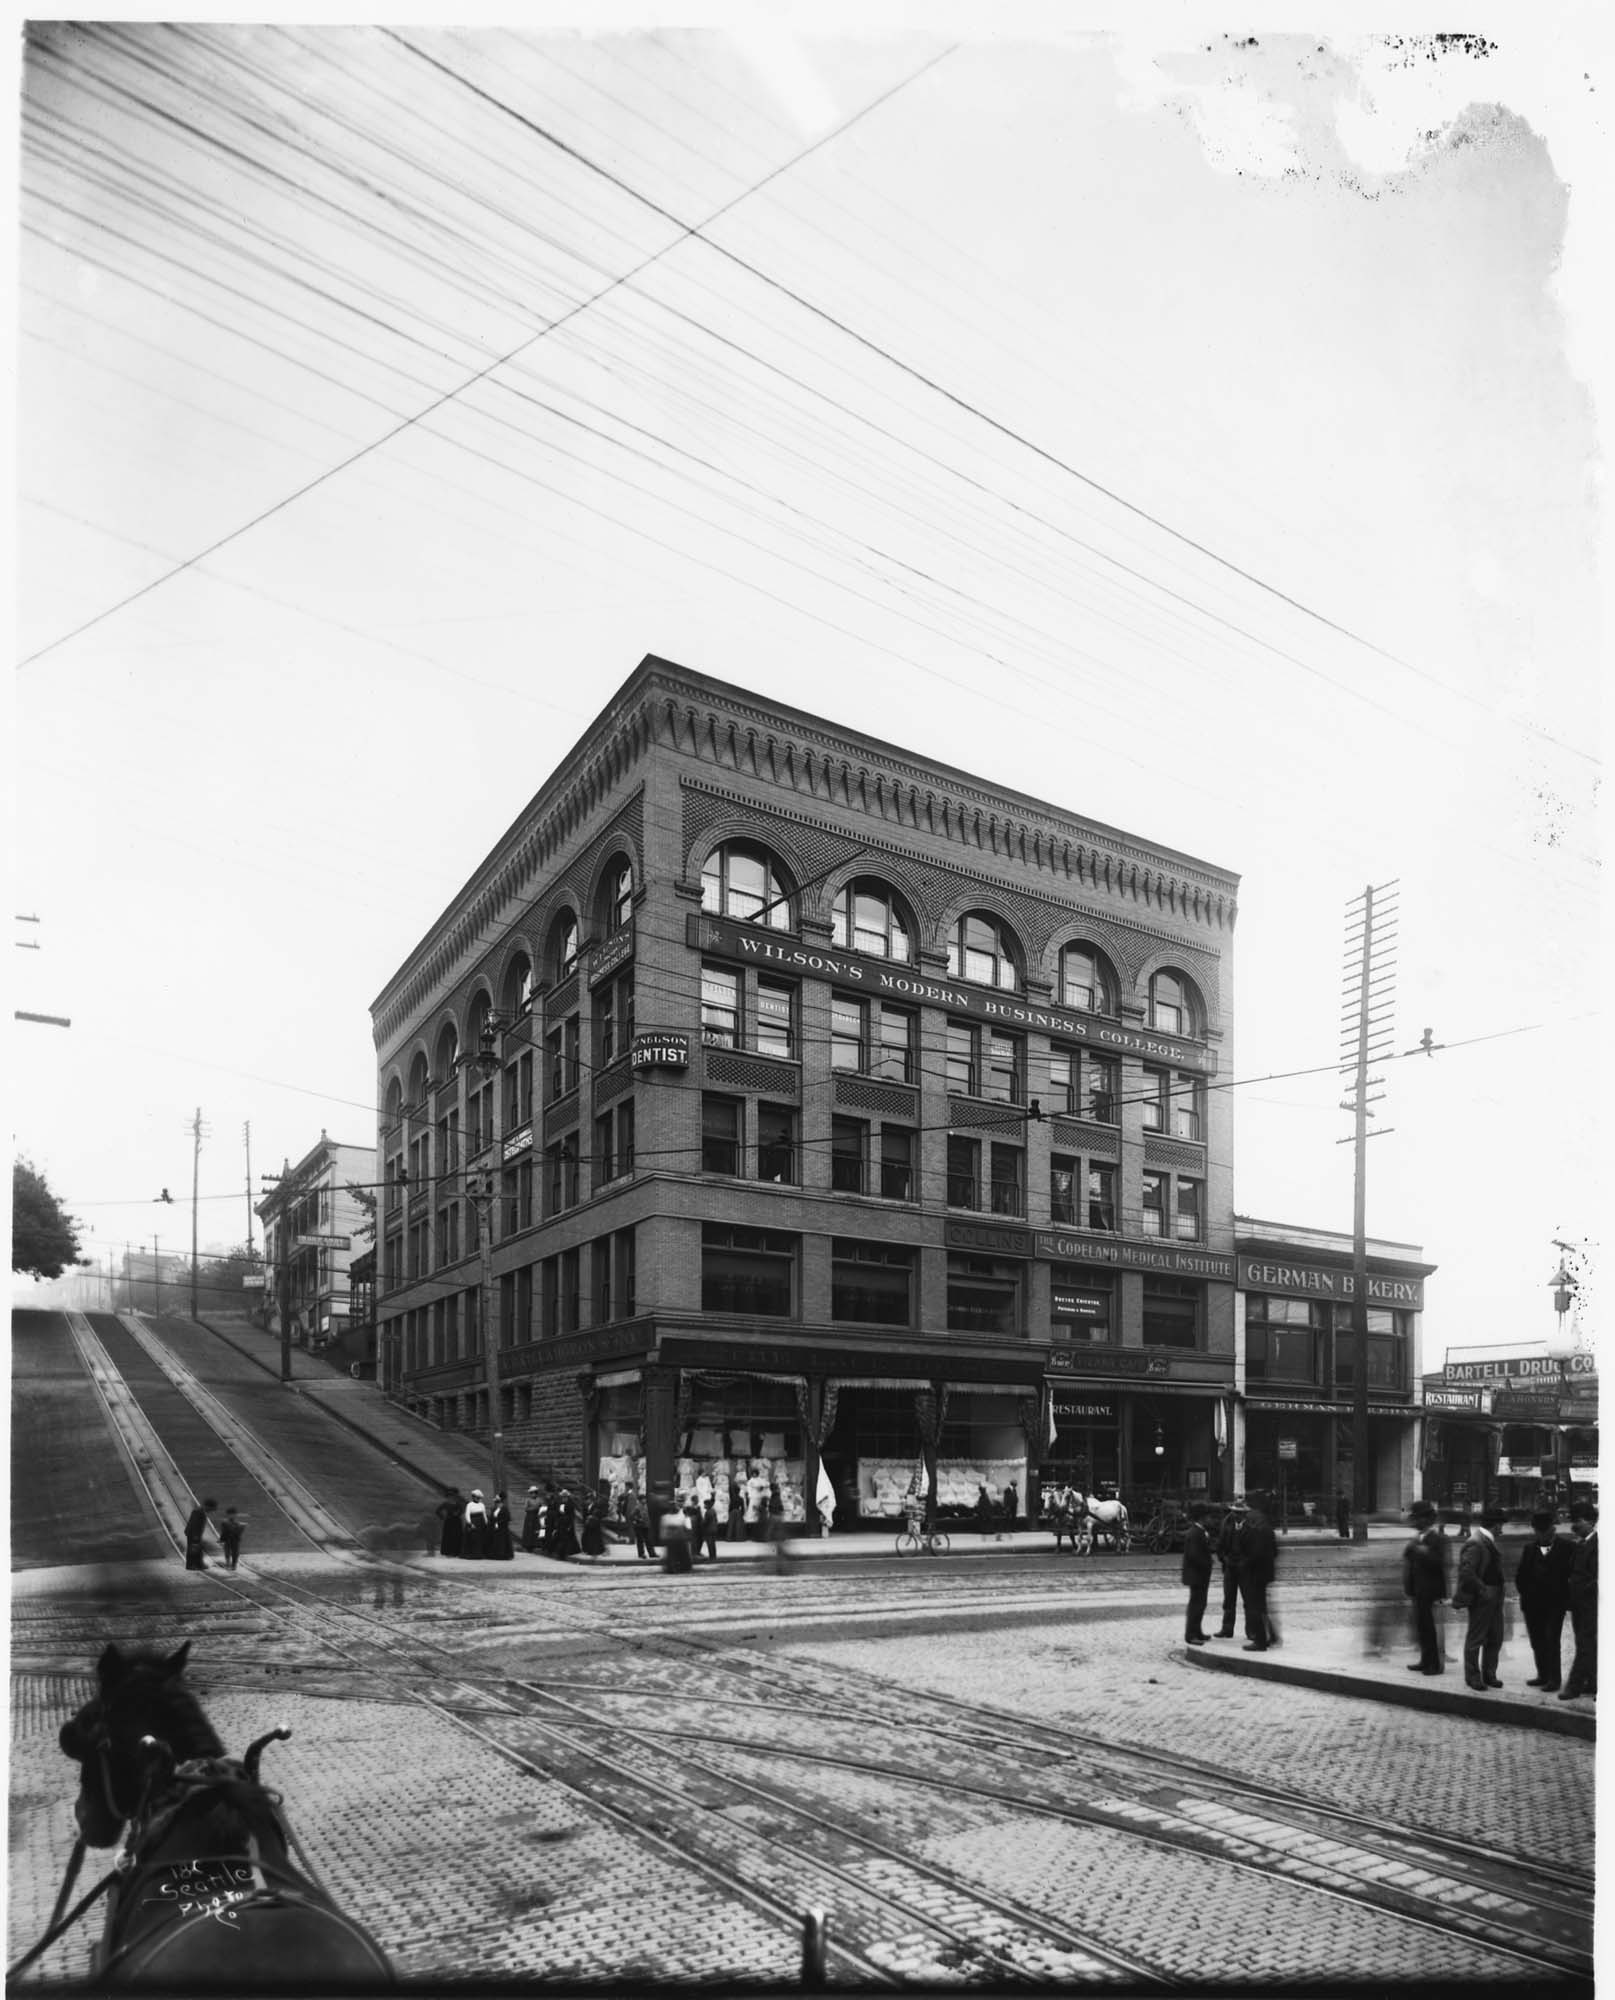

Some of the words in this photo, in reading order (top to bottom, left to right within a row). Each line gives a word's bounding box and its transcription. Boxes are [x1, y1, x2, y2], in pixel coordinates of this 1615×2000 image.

[739, 937, 864, 980] WILSON'S
[880, 974, 969, 1007] MODERN
[985, 1002, 1088, 1036] BUSINESS
[631, 1048, 688, 1067] DENTIST.
[1039, 1235, 1055, 1247] THE
[1057, 1238, 1118, 1262] COPELAND
[1122, 1248, 1172, 1267] MEDICAL
[1175, 1254, 1231, 1275] INSTITUTE
[1248, 1264, 1334, 1291] GERMAN
[1343, 1276, 1418, 1303] BKERY.
[1446, 1364, 1514, 1381] BARTELL
[1425, 1392, 1480, 1408] RESTAURANT
